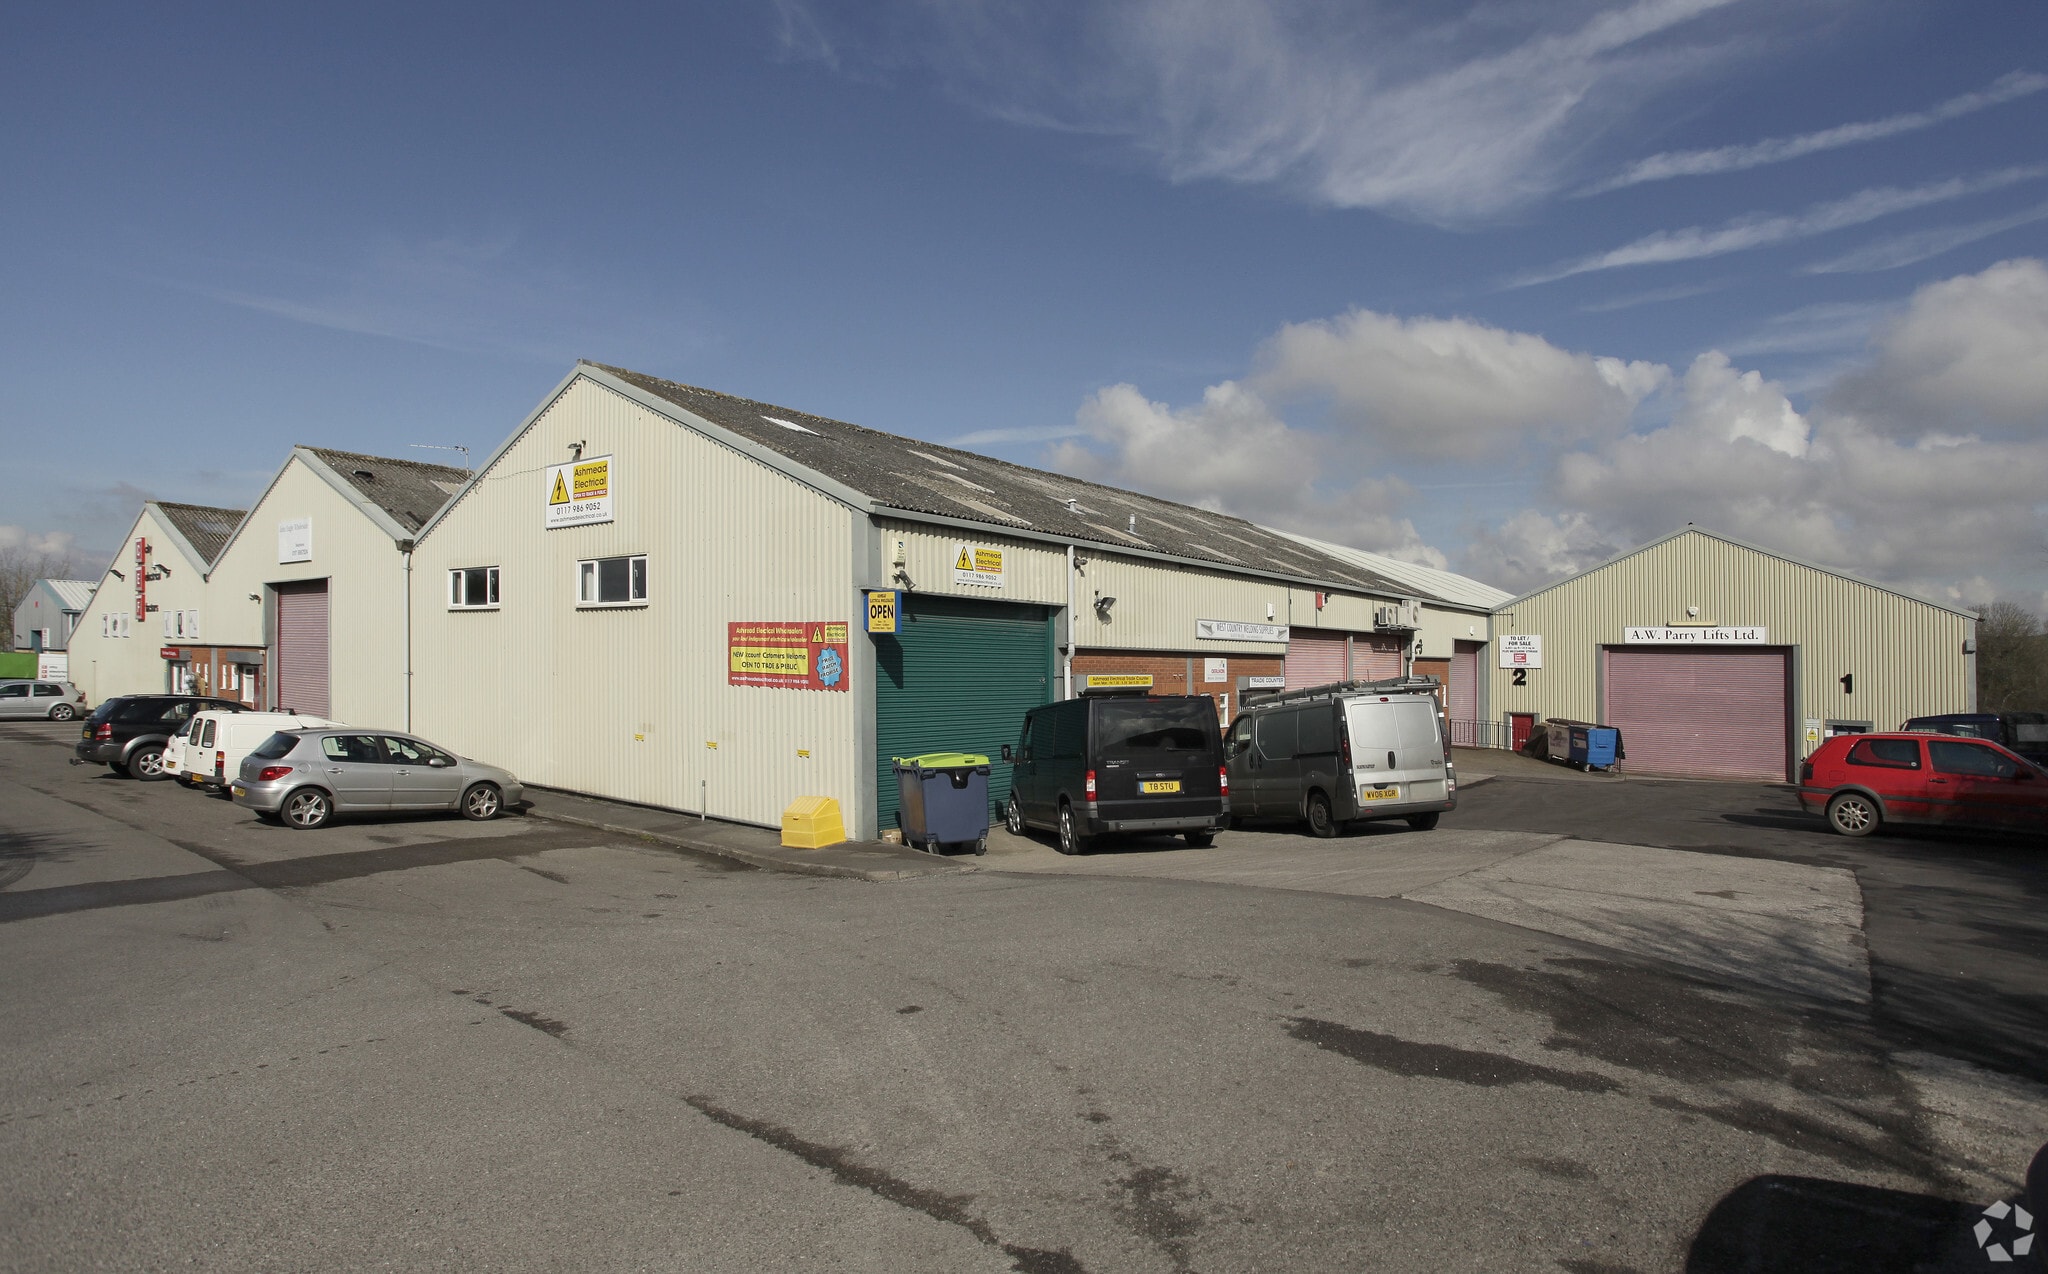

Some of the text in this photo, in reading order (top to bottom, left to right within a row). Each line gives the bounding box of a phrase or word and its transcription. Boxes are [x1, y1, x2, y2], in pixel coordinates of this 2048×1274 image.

[574, 463, 608, 477] Ashmead
[574, 476, 607, 490] Electrical
[557, 501, 602, 516] 0117 986 9052
[976, 550, 1002, 559] Ashmead
[976, 558, 1002, 567] Electrical
[870, 604, 894, 619] OPEN
[1216, 622, 1227, 632] WEST
[1227, 622, 1243, 633] COUNTRY
[1259, 625, 1275, 635] SUPPLIES
[1632, 629, 1759, 643] A.W. Parry Lifts Ltd.
[1512, 668, 1527, 686] 2
[1840, 673, 1853, 695] 1
[1160, 782, 1174, 790] STU
[1366, 789, 1396, 799] WV06 XGR
